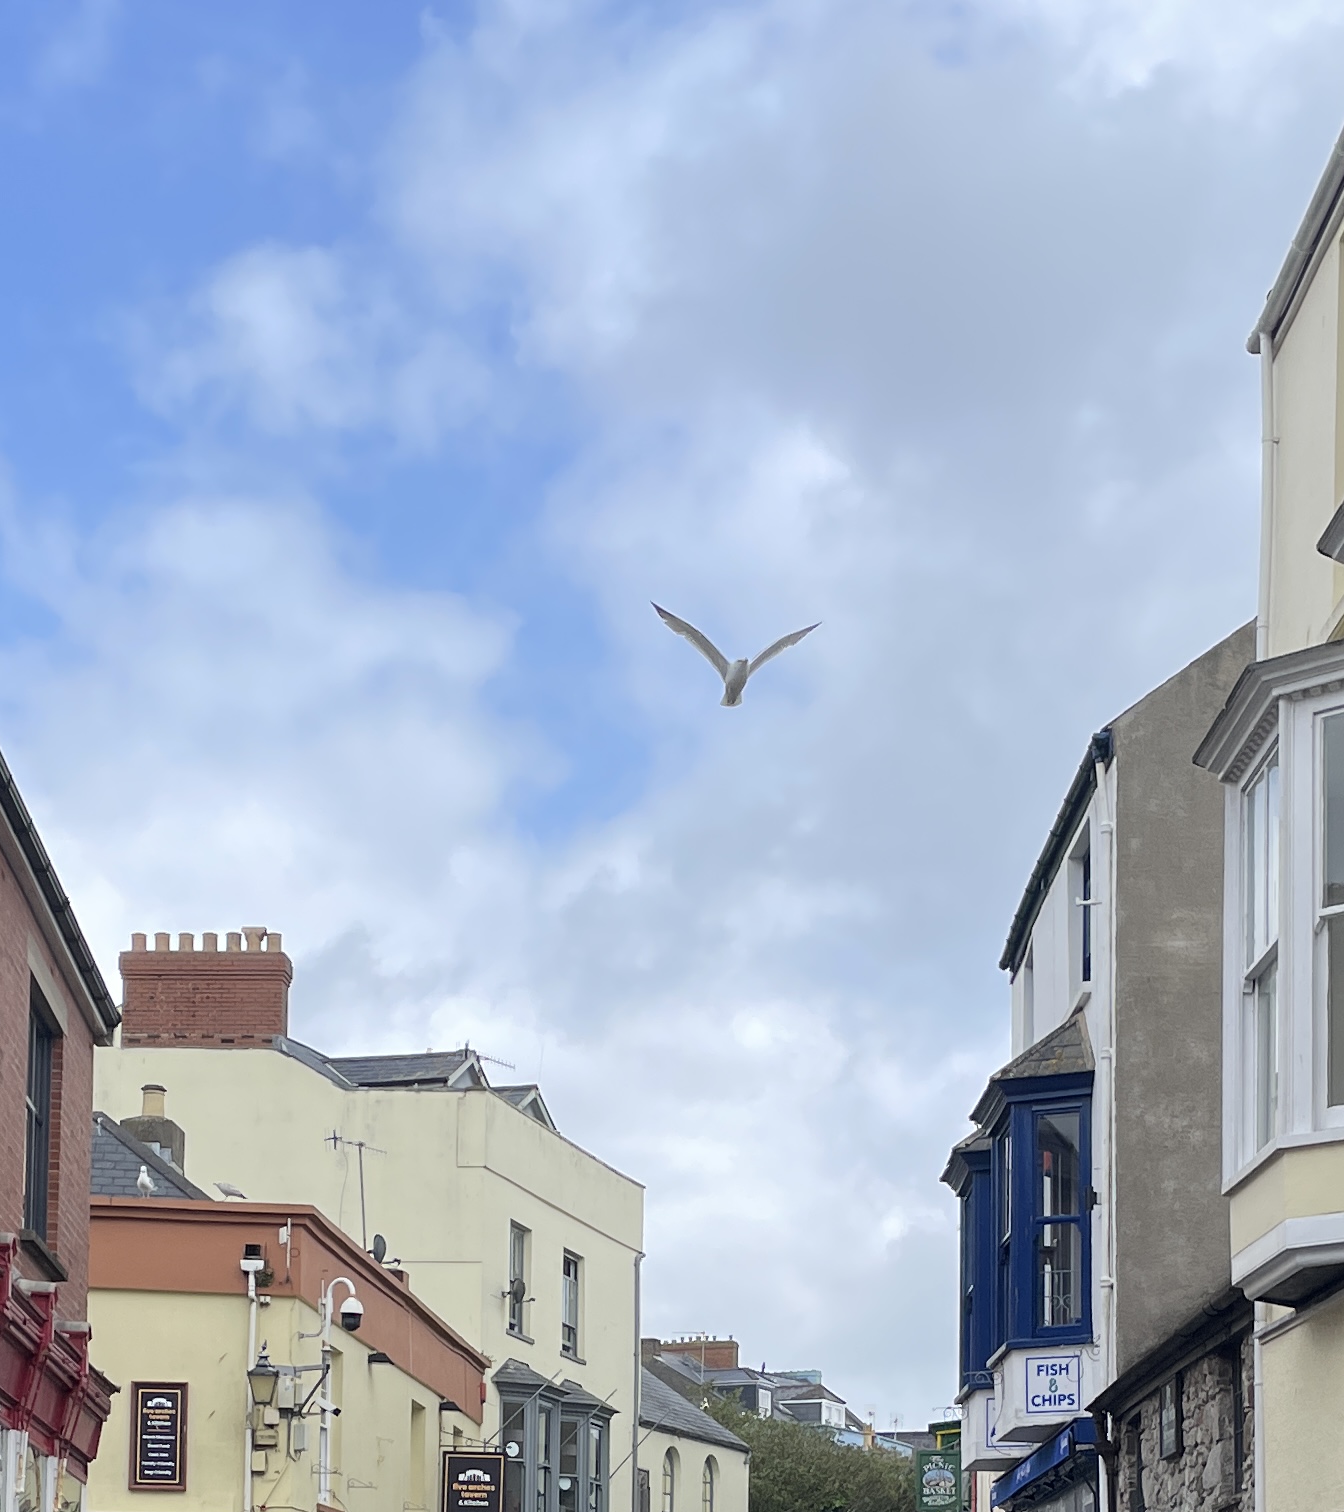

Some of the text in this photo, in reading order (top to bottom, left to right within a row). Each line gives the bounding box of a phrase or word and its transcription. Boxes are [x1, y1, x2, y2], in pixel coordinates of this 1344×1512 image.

[1037, 1364, 1069, 1377] FISH
[1049, 1378, 1058, 1393] &
[1031, 1394, 1075, 1407] CHIPS
[923, 1487, 956, 1495] BASKET
